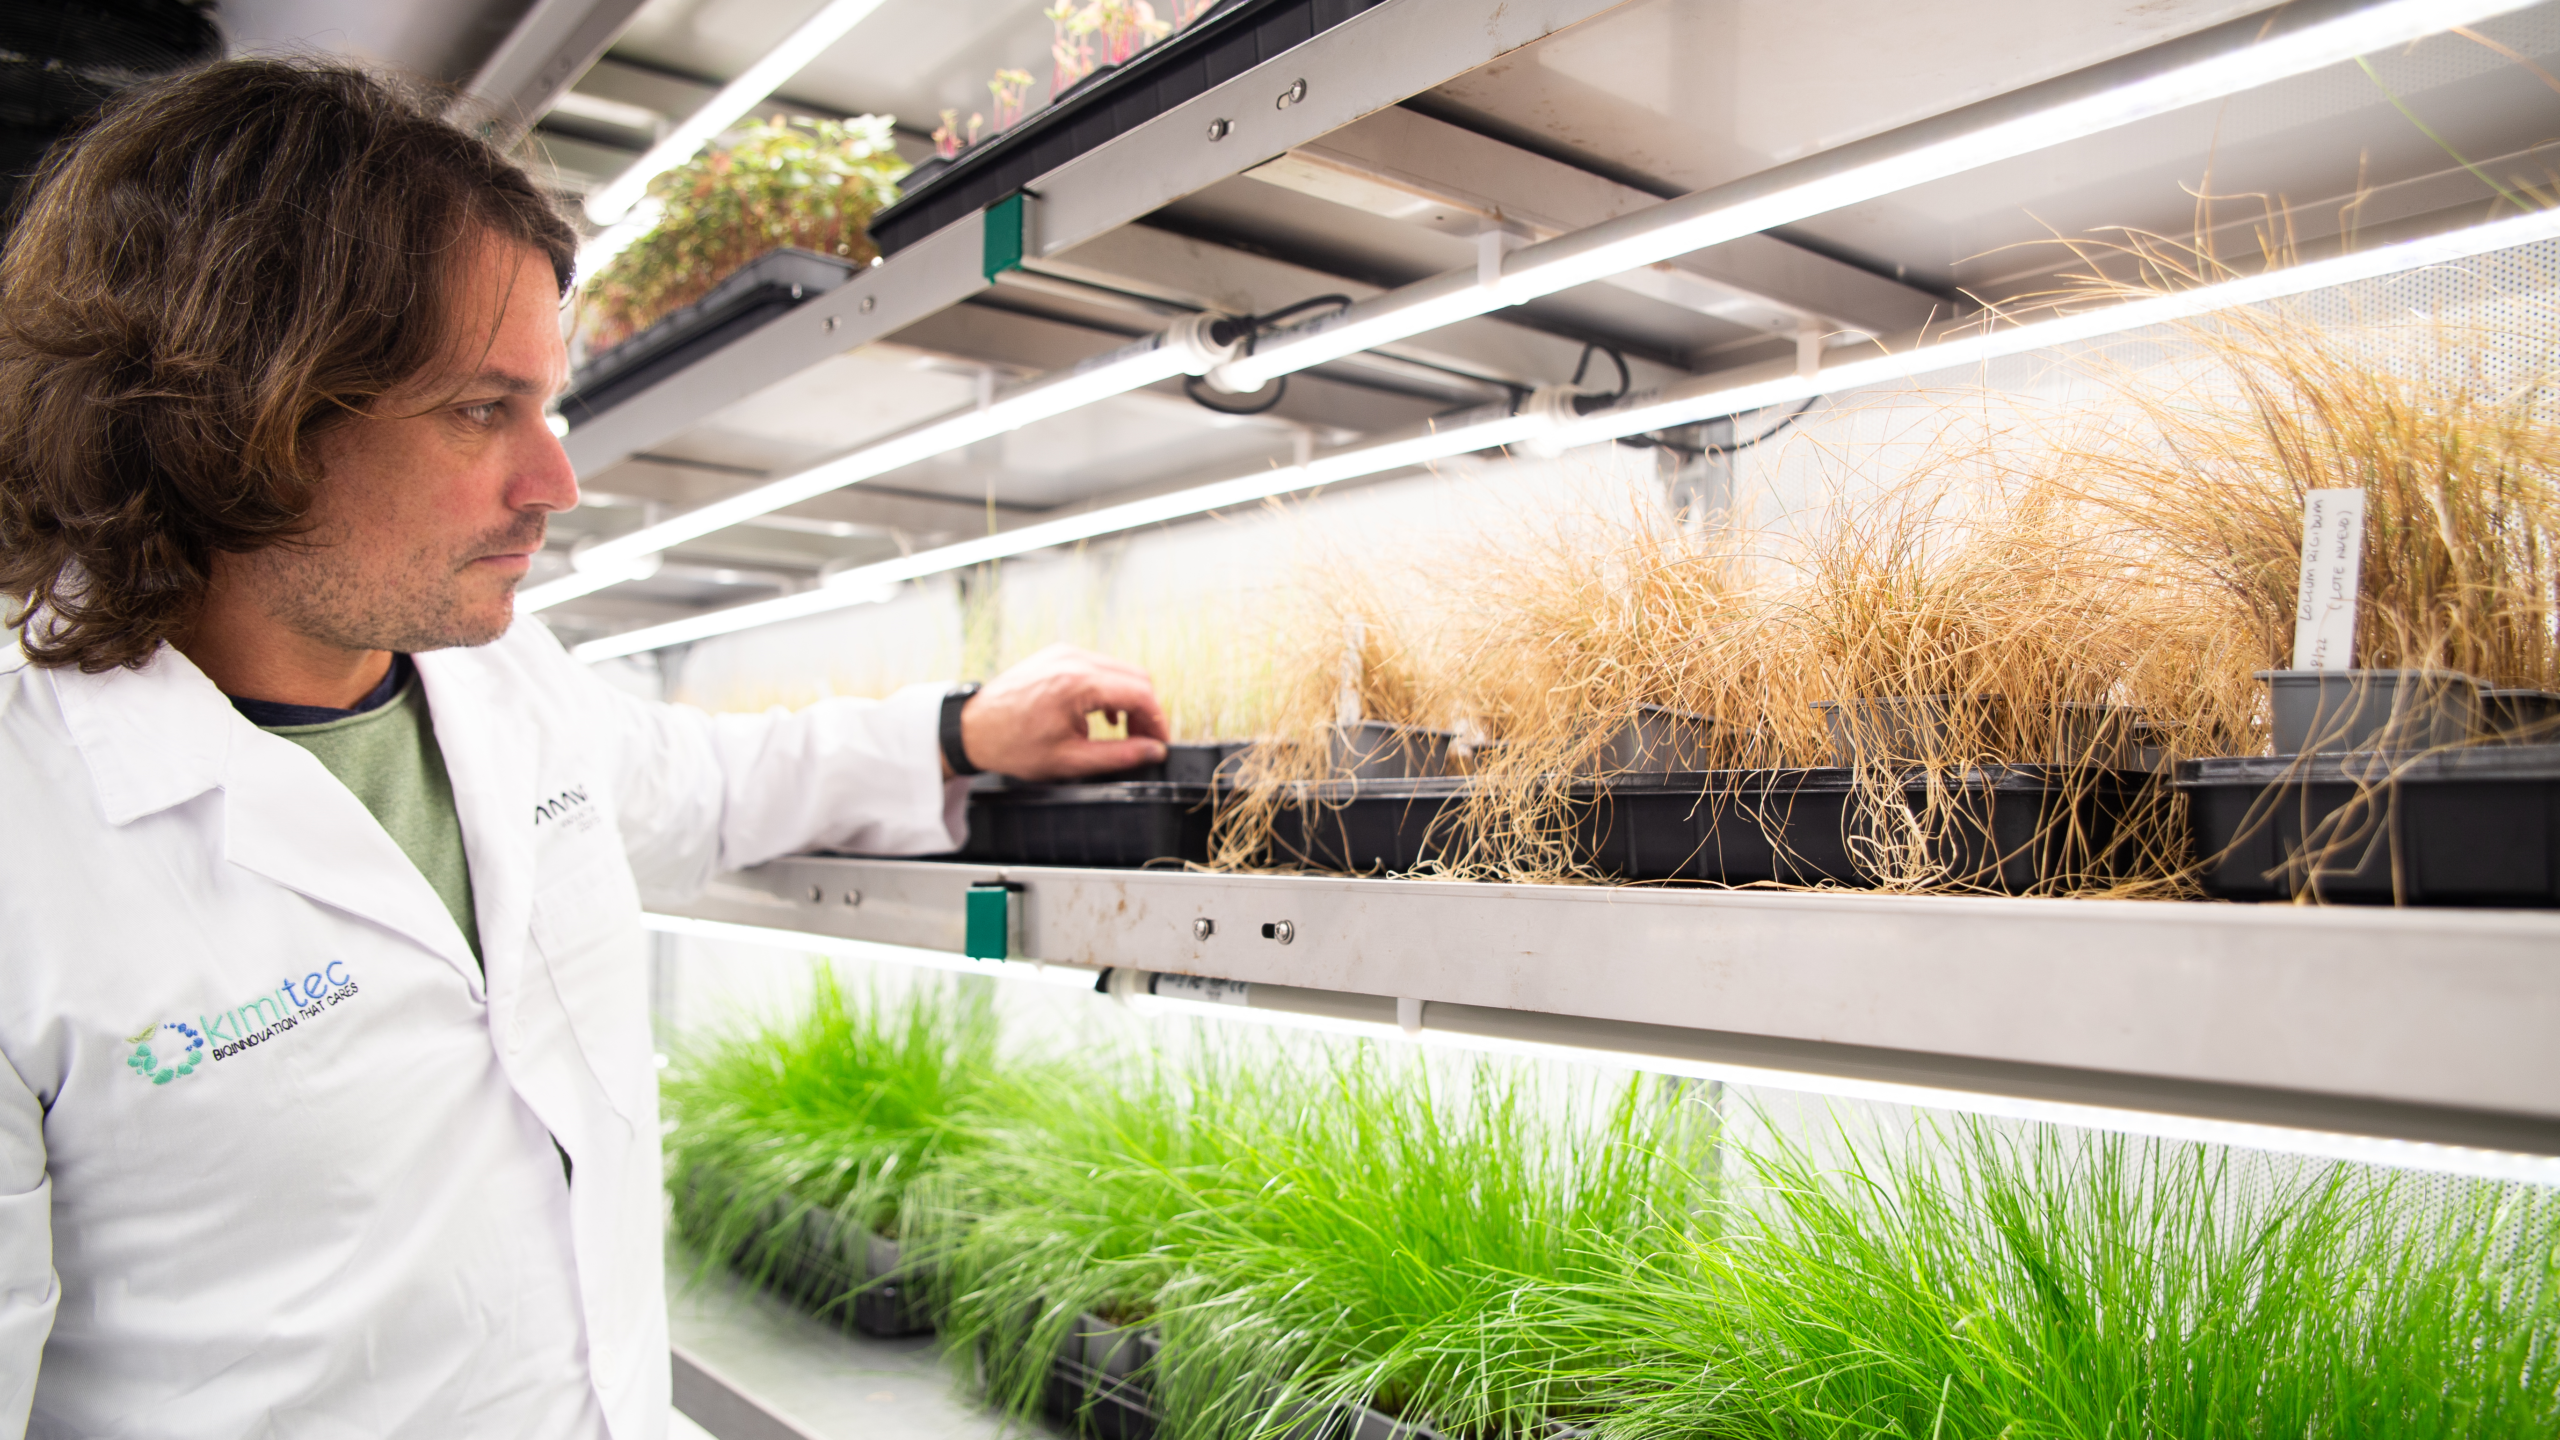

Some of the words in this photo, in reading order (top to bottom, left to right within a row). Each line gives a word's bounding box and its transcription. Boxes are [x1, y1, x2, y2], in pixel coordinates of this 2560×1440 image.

[199, 960, 350, 1048] kimitec
[212, 1014, 299, 1062] BIOINNOVATION
[299, 1000, 326, 1021] THAT
[326, 982, 360, 1007] CARES
